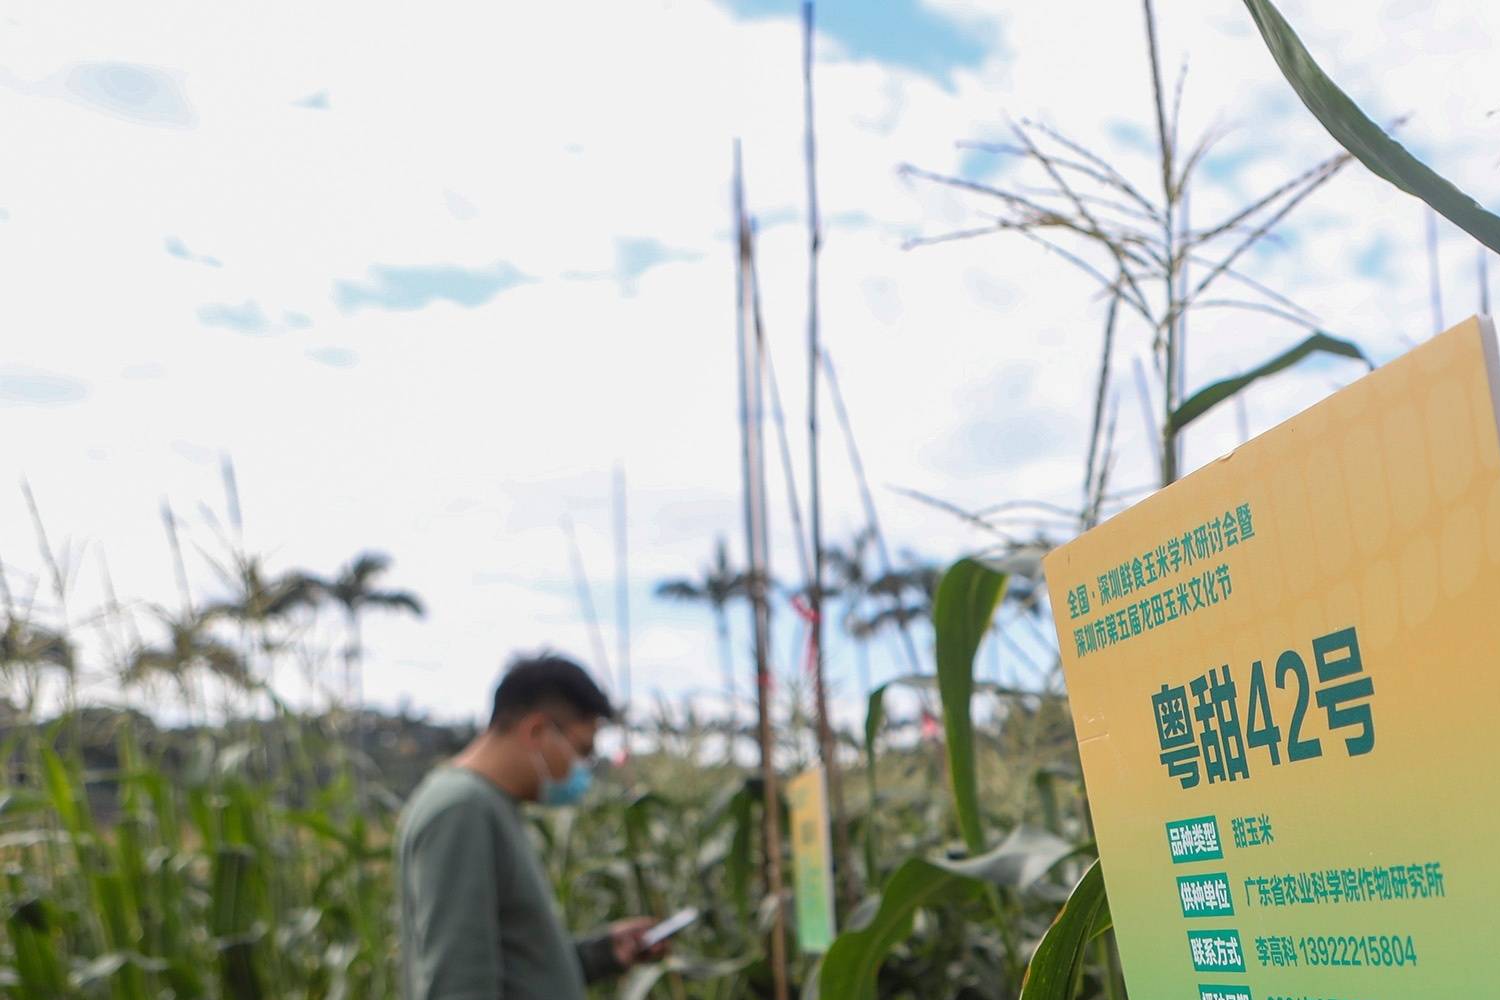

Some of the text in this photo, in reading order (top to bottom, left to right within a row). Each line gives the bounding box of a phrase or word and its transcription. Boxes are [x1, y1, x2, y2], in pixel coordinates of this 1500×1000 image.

[1074, 564, 1232, 658] 深圳市第五届龙田玉米文化节
[1151, 626, 1375, 790] 粤甜42号
[1169, 813, 1275, 857] 品种类型 甜玉米
[1180, 861, 1445, 911] 供种单位 广东省农业科学院作物研究所
[1190, 935, 1417, 967] 联系方式 李高科 13922215804
